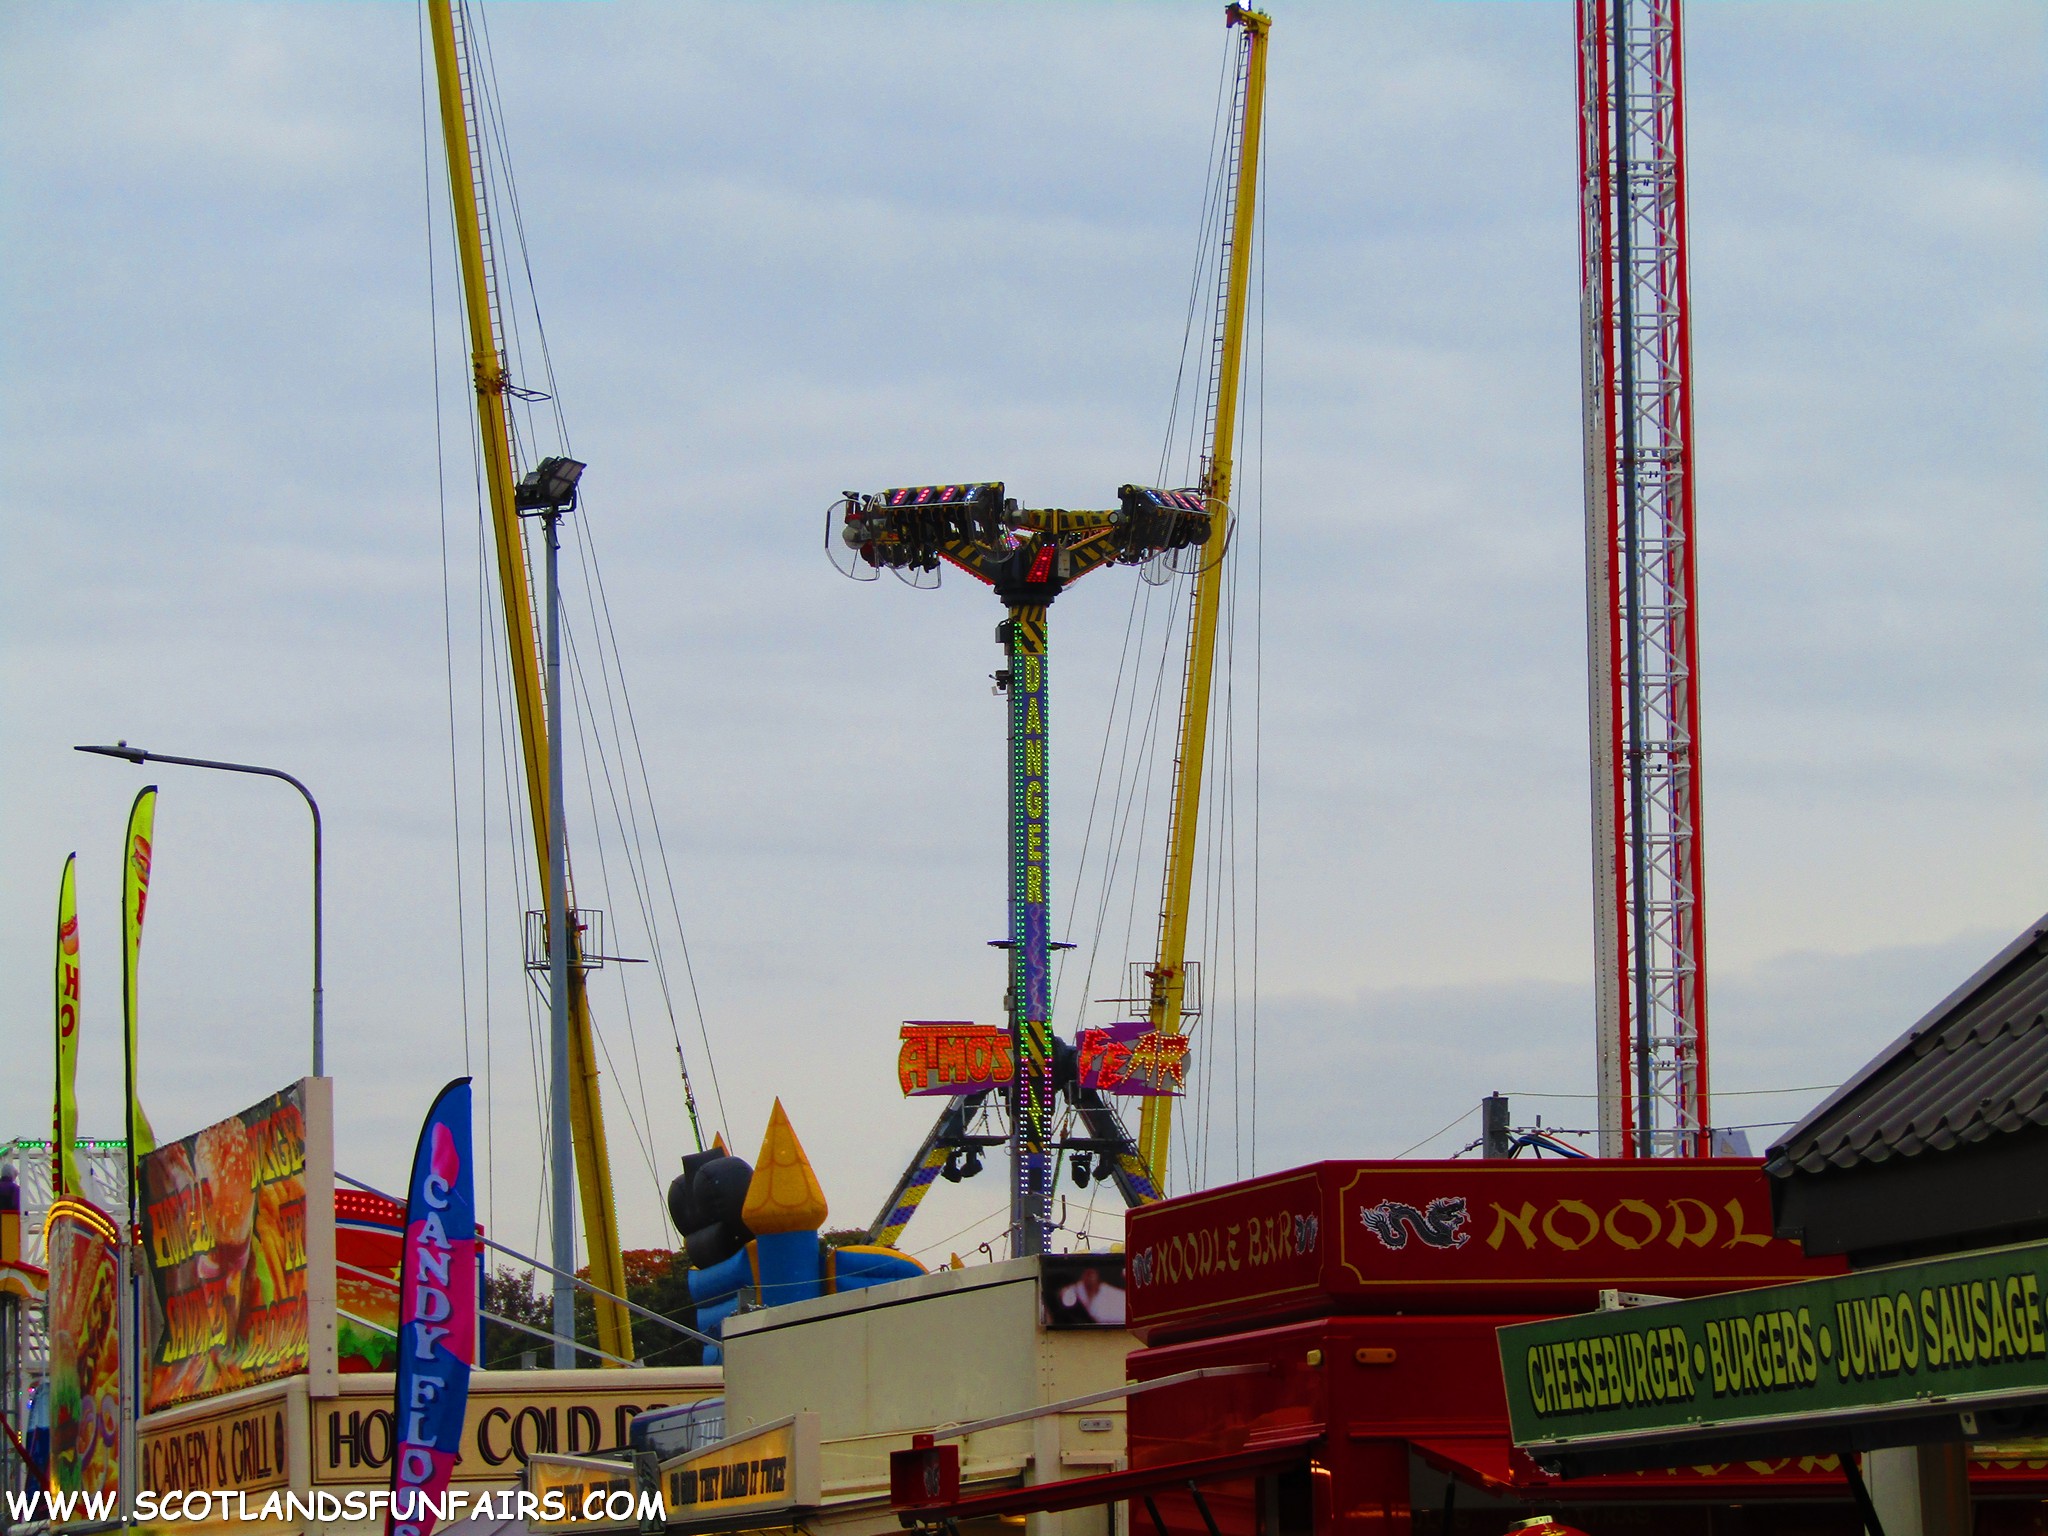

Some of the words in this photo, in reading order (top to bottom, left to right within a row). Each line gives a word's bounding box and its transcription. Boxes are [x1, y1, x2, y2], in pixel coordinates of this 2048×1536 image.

[1025, 655, 1042, 904] DANGER
[898, 1025, 1015, 1098] ATMOS
[1078, 1025, 1192, 1092] FEAR
[1155, 1222, 1241, 1285] NOODLE
[1247, 1210, 1293, 1267] BAR
[1486, 1198, 1802, 1250] NOODL
[416, 1174, 452, 1360] CANDY
[1526, 1325, 1696, 1416] CHEESEBURGER
[1705, 1307, 1819, 1395] BURGERS
[1834, 1291, 1920, 1381] JUMBO
[1920, 1273, 2047, 1370] SAUSAGE
[153, 1428, 212, 1499] CARVERY
[216, 1425, 228, 1488] &
[231, 1414, 272, 1485] GRILL
[329, 1409, 395, 1469] HO
